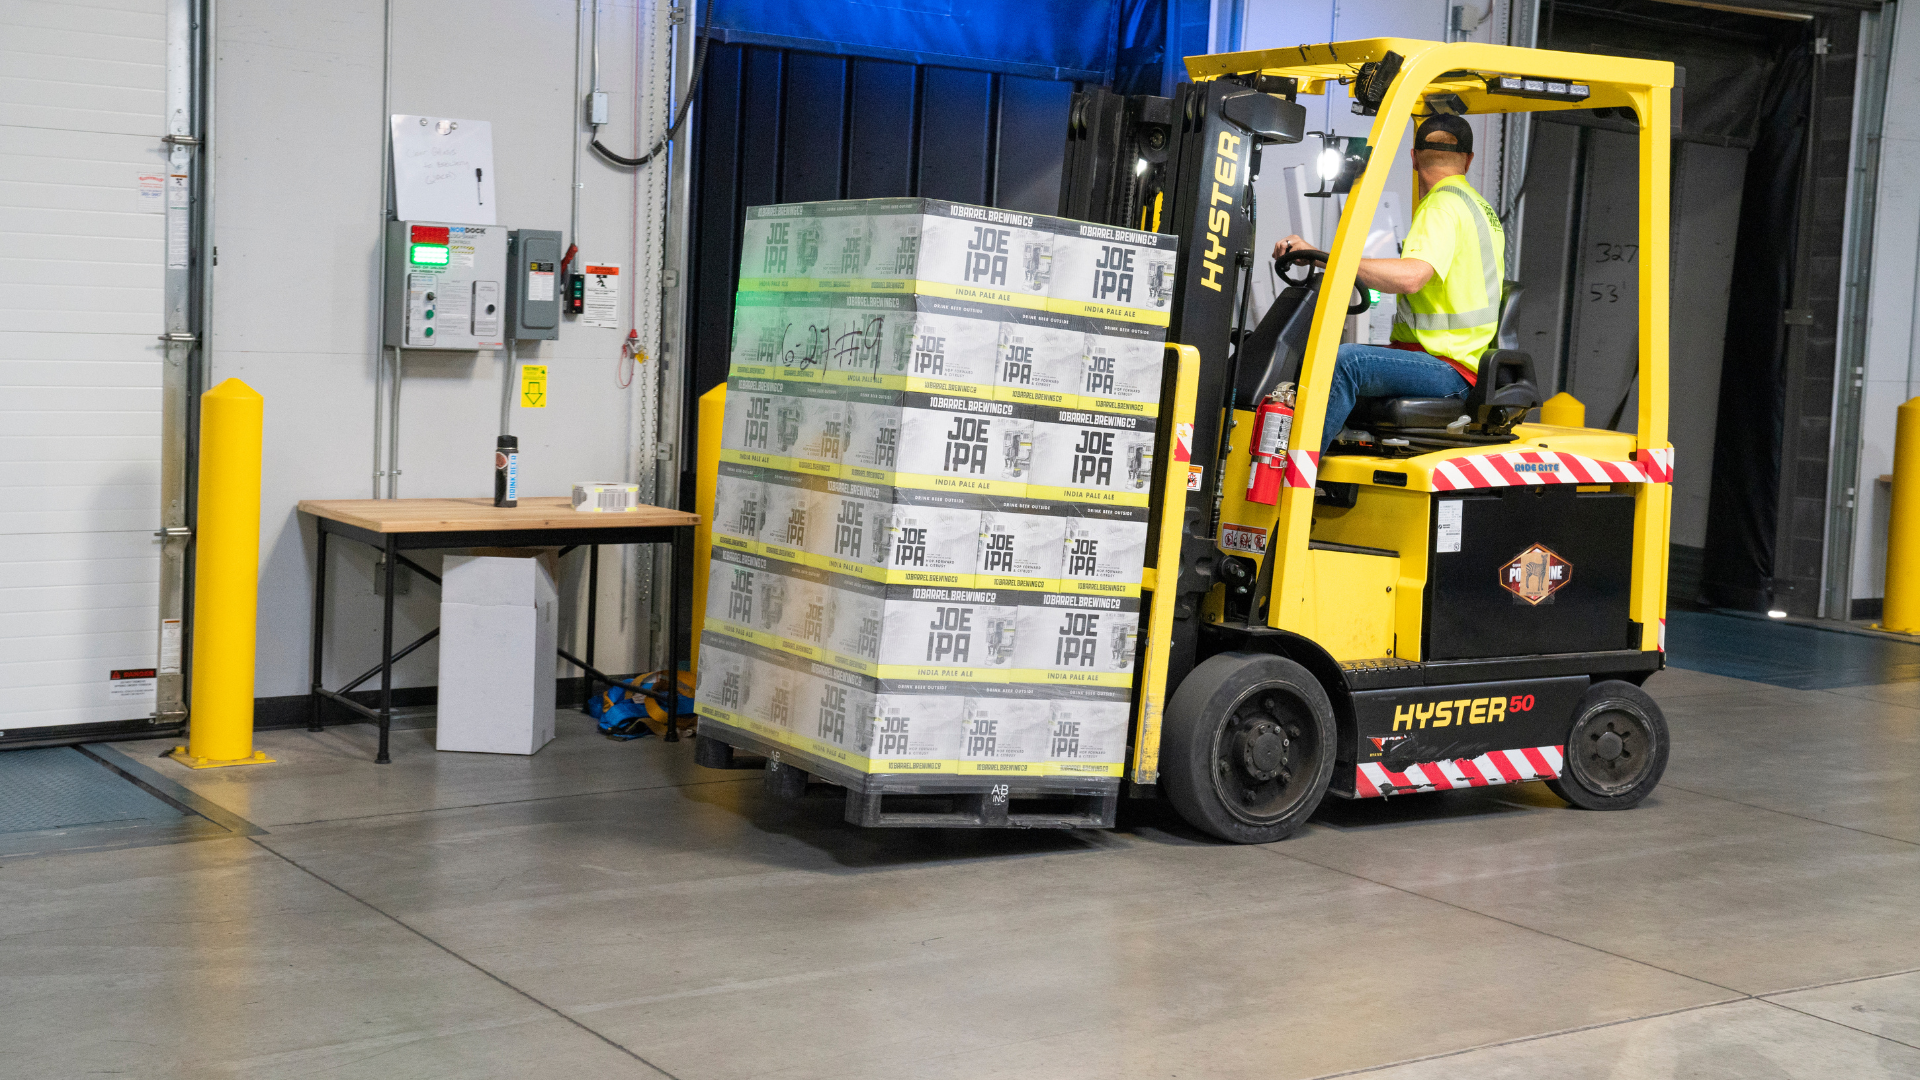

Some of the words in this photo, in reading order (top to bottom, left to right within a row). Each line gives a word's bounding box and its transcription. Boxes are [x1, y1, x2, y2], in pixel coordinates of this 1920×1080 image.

[1200, 130, 1240, 292] HYSTER
[767, 222, 790, 244] JOE
[968, 227, 1010, 254] JOE
[843, 237, 861, 253] JOE
[897, 237, 917, 253] JOE
[1596, 243, 1638, 263] 327
[764, 245, 788, 274] IPA
[841, 254, 860, 273] IPA
[895, 254, 915, 275] IPA
[964, 251, 1008, 286] IPA
[1096, 246, 1136, 272] JOE
[956, 288, 976, 297] INDIA
[979, 291, 995, 299] PALE
[1092, 270, 1133, 303] IPA
[1085, 306, 1104, 314] INDIA
[1106, 308, 1122, 316] PALE
[1124, 310, 1136, 318] ALE
[916, 335, 946, 354] JOE
[1005, 345, 1033, 363] JOE
[914, 353, 945, 375] IPA
[1003, 362, 1032, 385] IPA
[1089, 356, 1115, 374] JOE
[1086, 372, 1114, 395] IPA
[746, 397, 771, 420] JOE
[744, 420, 768, 449] IPA
[823, 421, 842, 438] JOE
[877, 428, 897, 445] JOE
[948, 417, 990, 443] JOE
[821, 438, 840, 459] IPA
[1075, 430, 1115, 455] JOE
[874, 445, 895, 467] IPA
[944, 442, 988, 474] IPA
[1072, 455, 1113, 486] IPA
[1514, 464, 1536, 472] RIDE
[1538, 464, 1560, 472] RITE
[935, 479, 956, 487] INDIA
[958, 480, 975, 488] PALE
[1064, 490, 1083, 498] INDIA
[741, 500, 757, 516] JOE
[789, 508, 806, 525] JOE
[837, 500, 864, 526] JOE
[739, 515, 756, 536] IPA
[786, 524, 805, 546] IPA
[898, 527, 927, 545] JOE
[834, 524, 862, 558] IPA
[986, 534, 1015, 551] JOE
[1071, 539, 1098, 556] JOE
[895, 545, 925, 566] IPA
[984, 551, 1013, 572] IPA
[1068, 555, 1096, 576] IPA
[731, 569, 754, 594] JOE
[728, 592, 753, 623] IPA
[806, 603, 824, 621] JOE
[860, 617, 878, 637] JOE
[930, 607, 973, 631] JOE
[1060, 613, 1100, 637] JOE
[803, 619, 822, 642] IPA
[858, 635, 877, 658] IPA
[926, 632, 971, 663] IPA
[1055, 637, 1097, 666] IPA
[723, 672, 740, 690] JOE
[721, 687, 738, 709] IPA
[772, 686, 789, 706] JOE
[820, 684, 847, 713] JOE
[771, 704, 788, 726] IPA
[1393, 697, 1507, 731] HYSTER
[1509, 694, 1535, 713] 50
[818, 708, 845, 744] IPA
[881, 717, 910, 733] JOE
[969, 720, 998, 736] JOE
[1053, 721, 1081, 737] JOE
[878, 734, 908, 755] IPA
[967, 736, 996, 757] IPA
[1051, 738, 1078, 758] IPA
